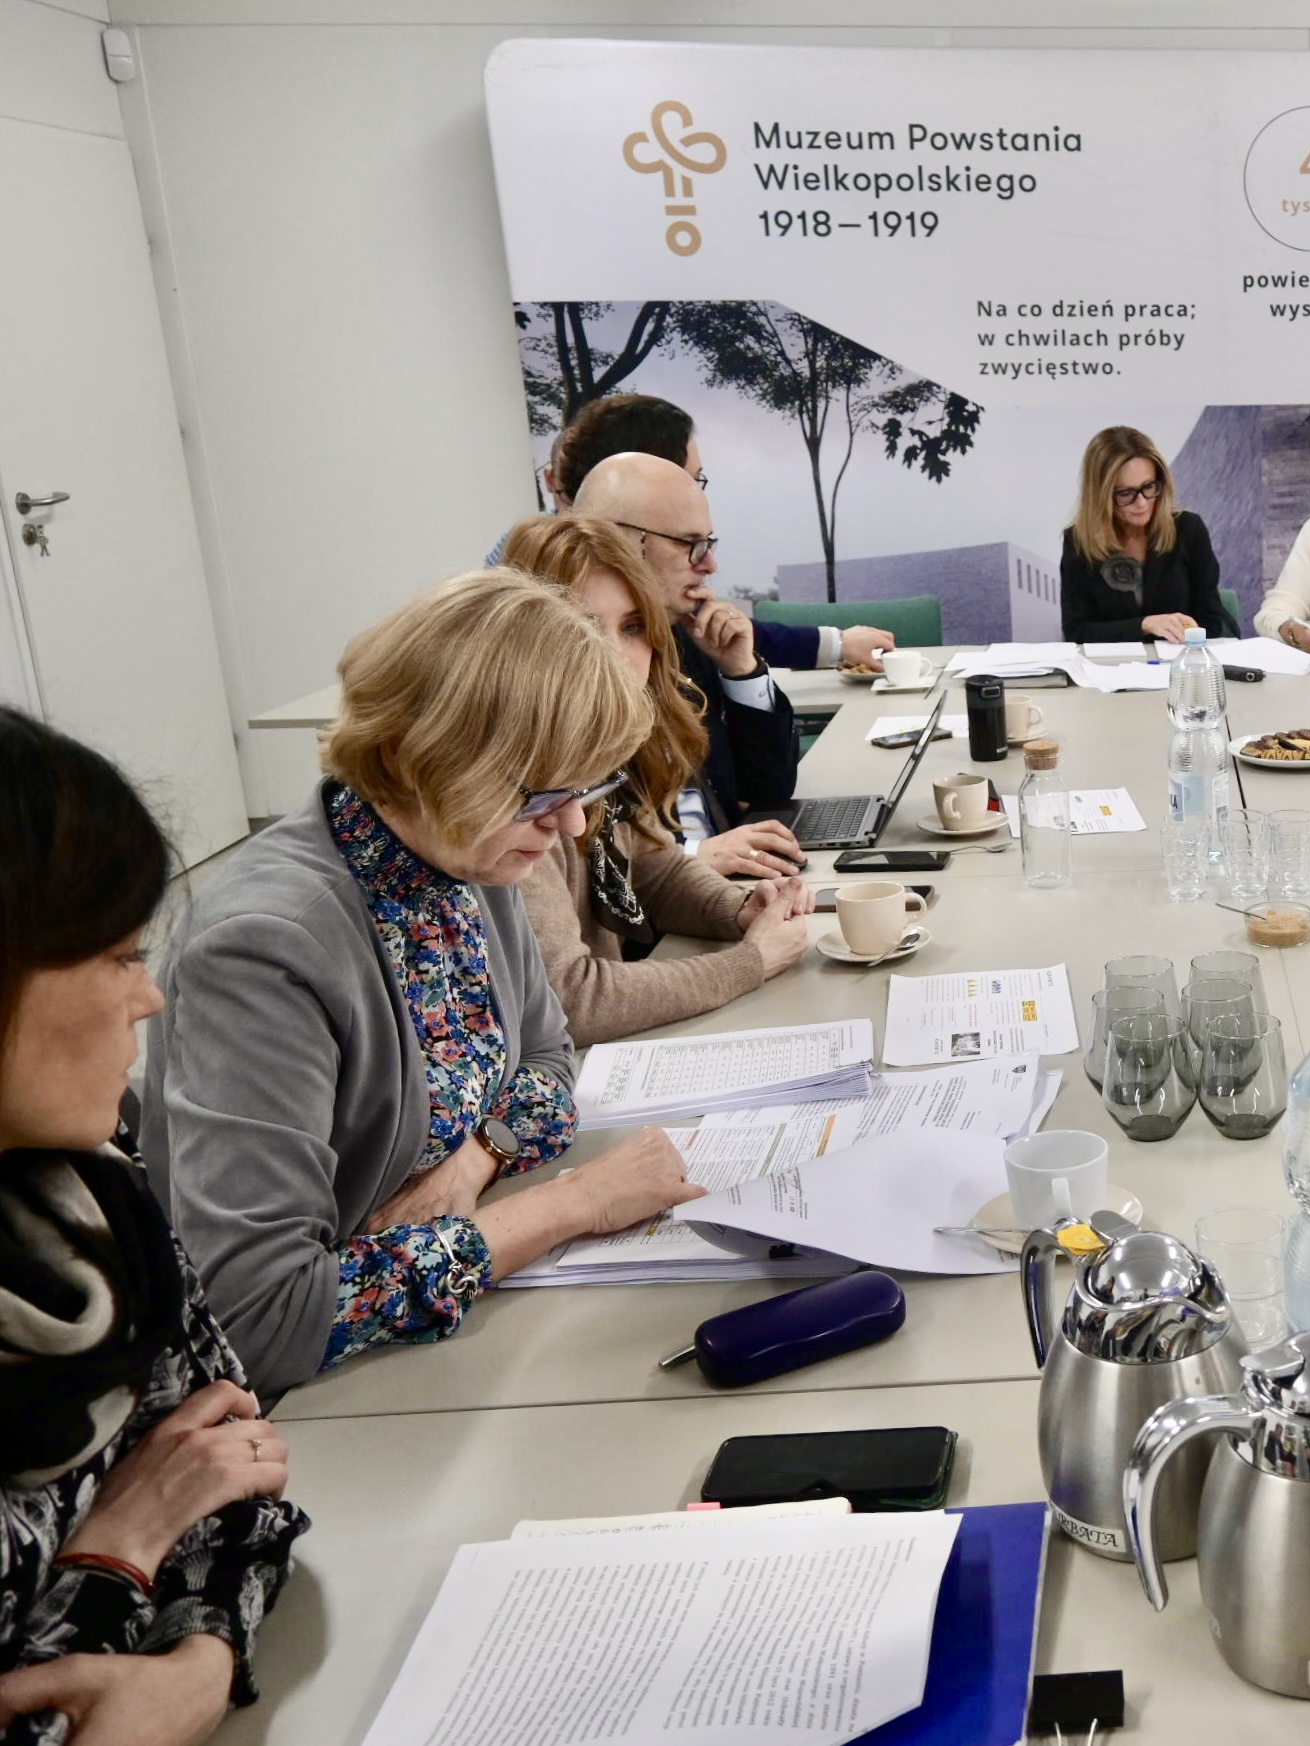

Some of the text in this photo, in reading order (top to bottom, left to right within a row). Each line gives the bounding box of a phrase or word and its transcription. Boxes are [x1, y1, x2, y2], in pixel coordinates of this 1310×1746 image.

[754, 122, 1081, 152] Muzeum Powstania
[754, 163, 1036, 200] Wielkopolskiego
[977, 300, 1195, 322] Na co dzień praca;
[978, 329, 1184, 351] w chwilach próby
[980, 358, 1120, 379] zwycięstwo.
[1056, 1512, 1118, 1547] RBATA
